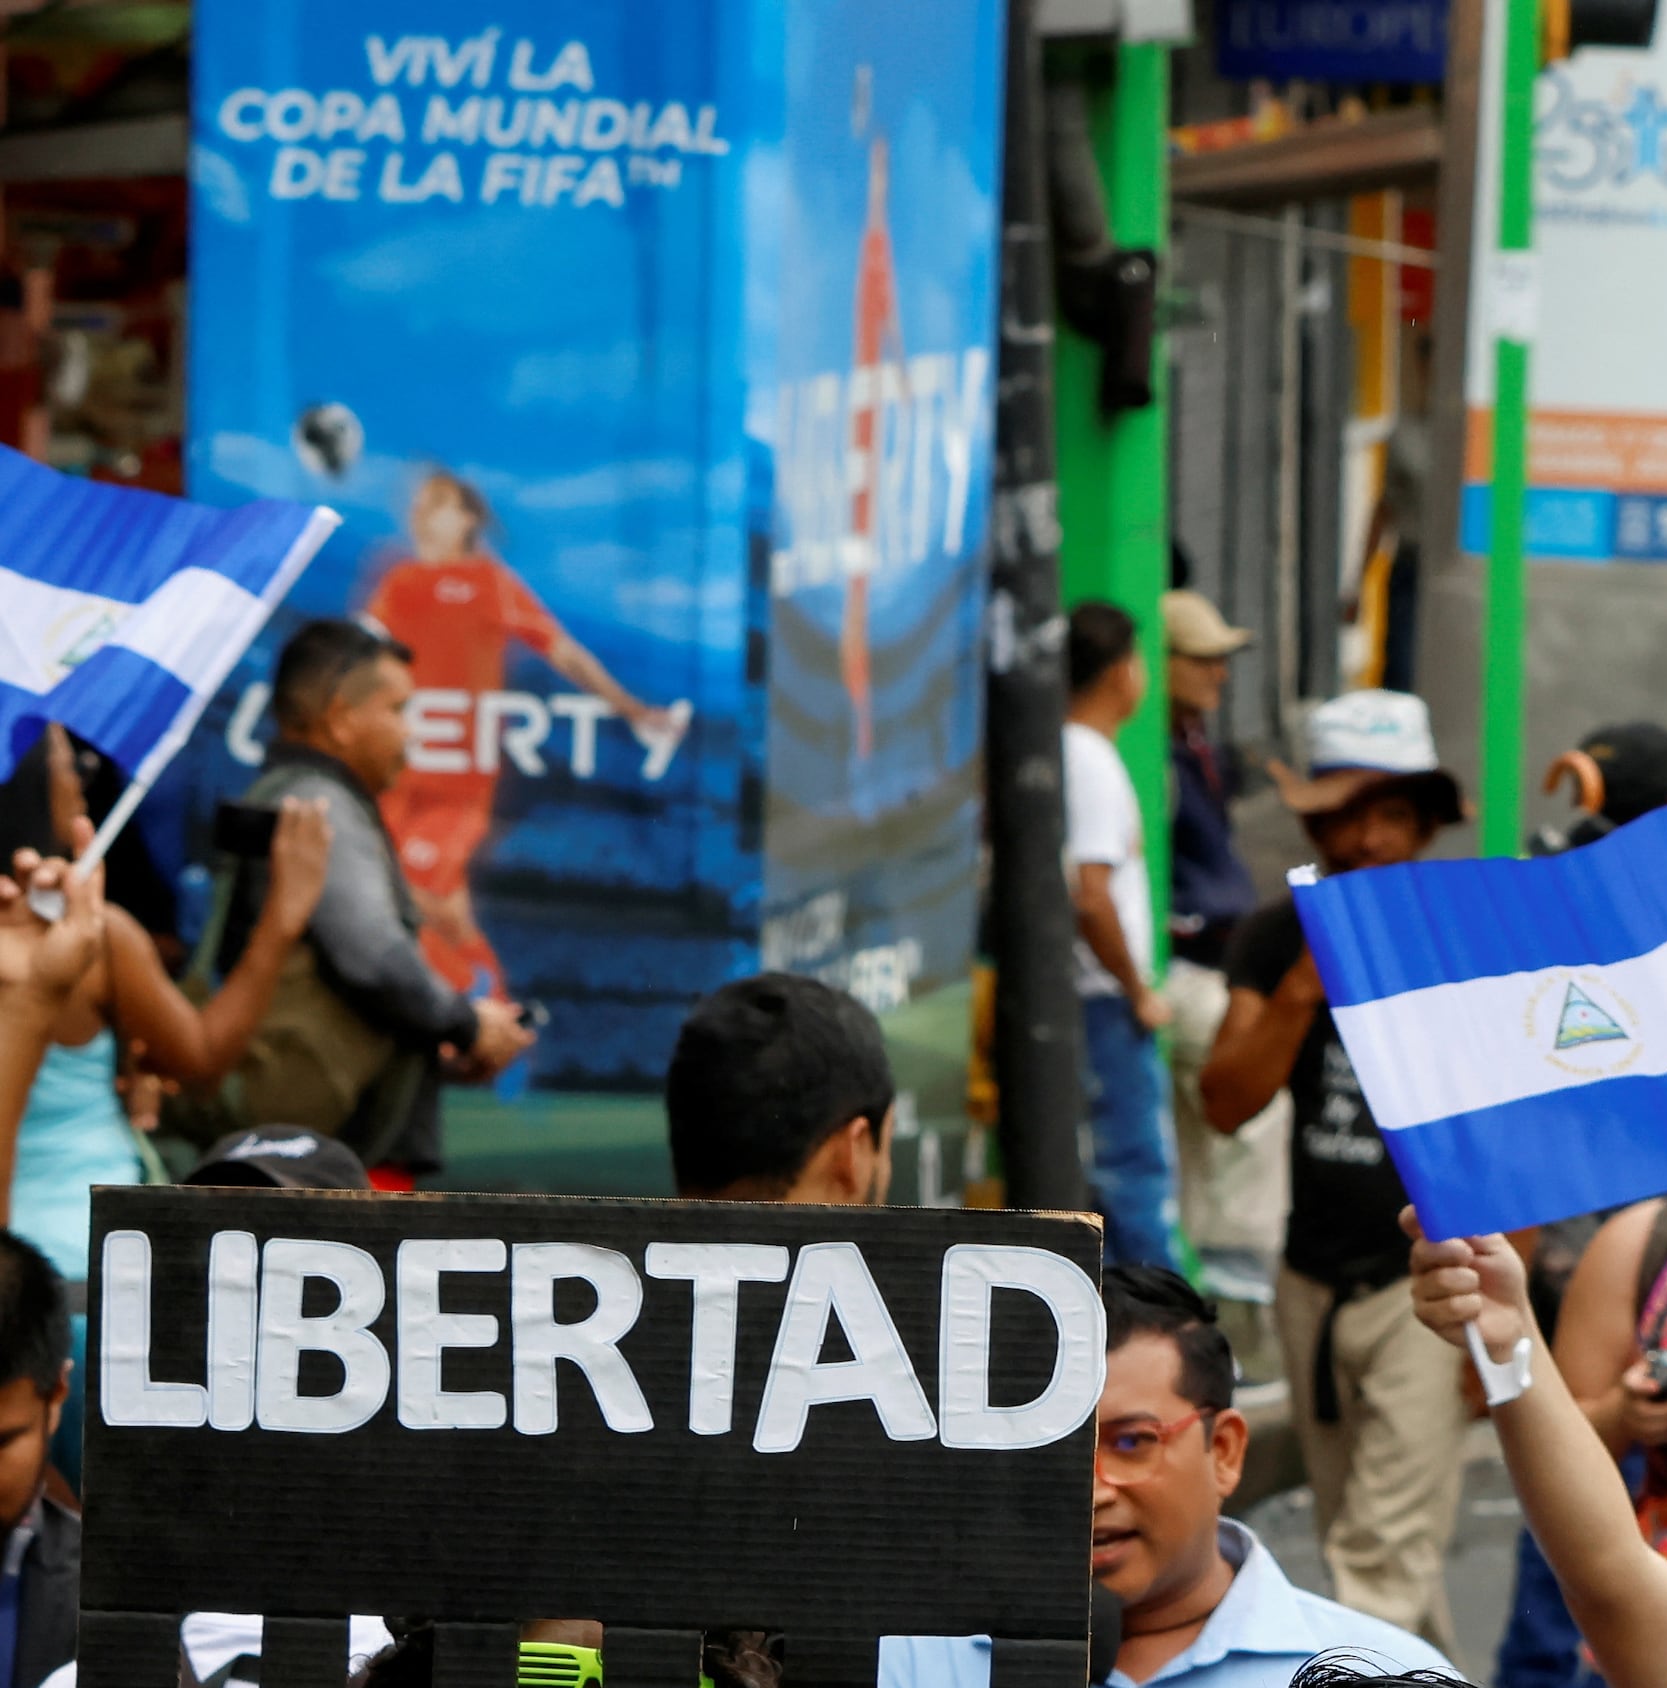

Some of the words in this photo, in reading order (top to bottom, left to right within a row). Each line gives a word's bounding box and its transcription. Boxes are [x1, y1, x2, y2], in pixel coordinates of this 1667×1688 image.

[365, 28, 499, 90] VIVÍ
[508, 41, 596, 93] LA
[217, 88, 405, 144] COPA
[421, 94, 730, 156] MUNDIAL
[269, 147, 369, 200] DE
[378, 151, 464, 203] LA
[226, 682, 694, 780] LERTY
[102, 1230, 1106, 1453] LIBERTAD
